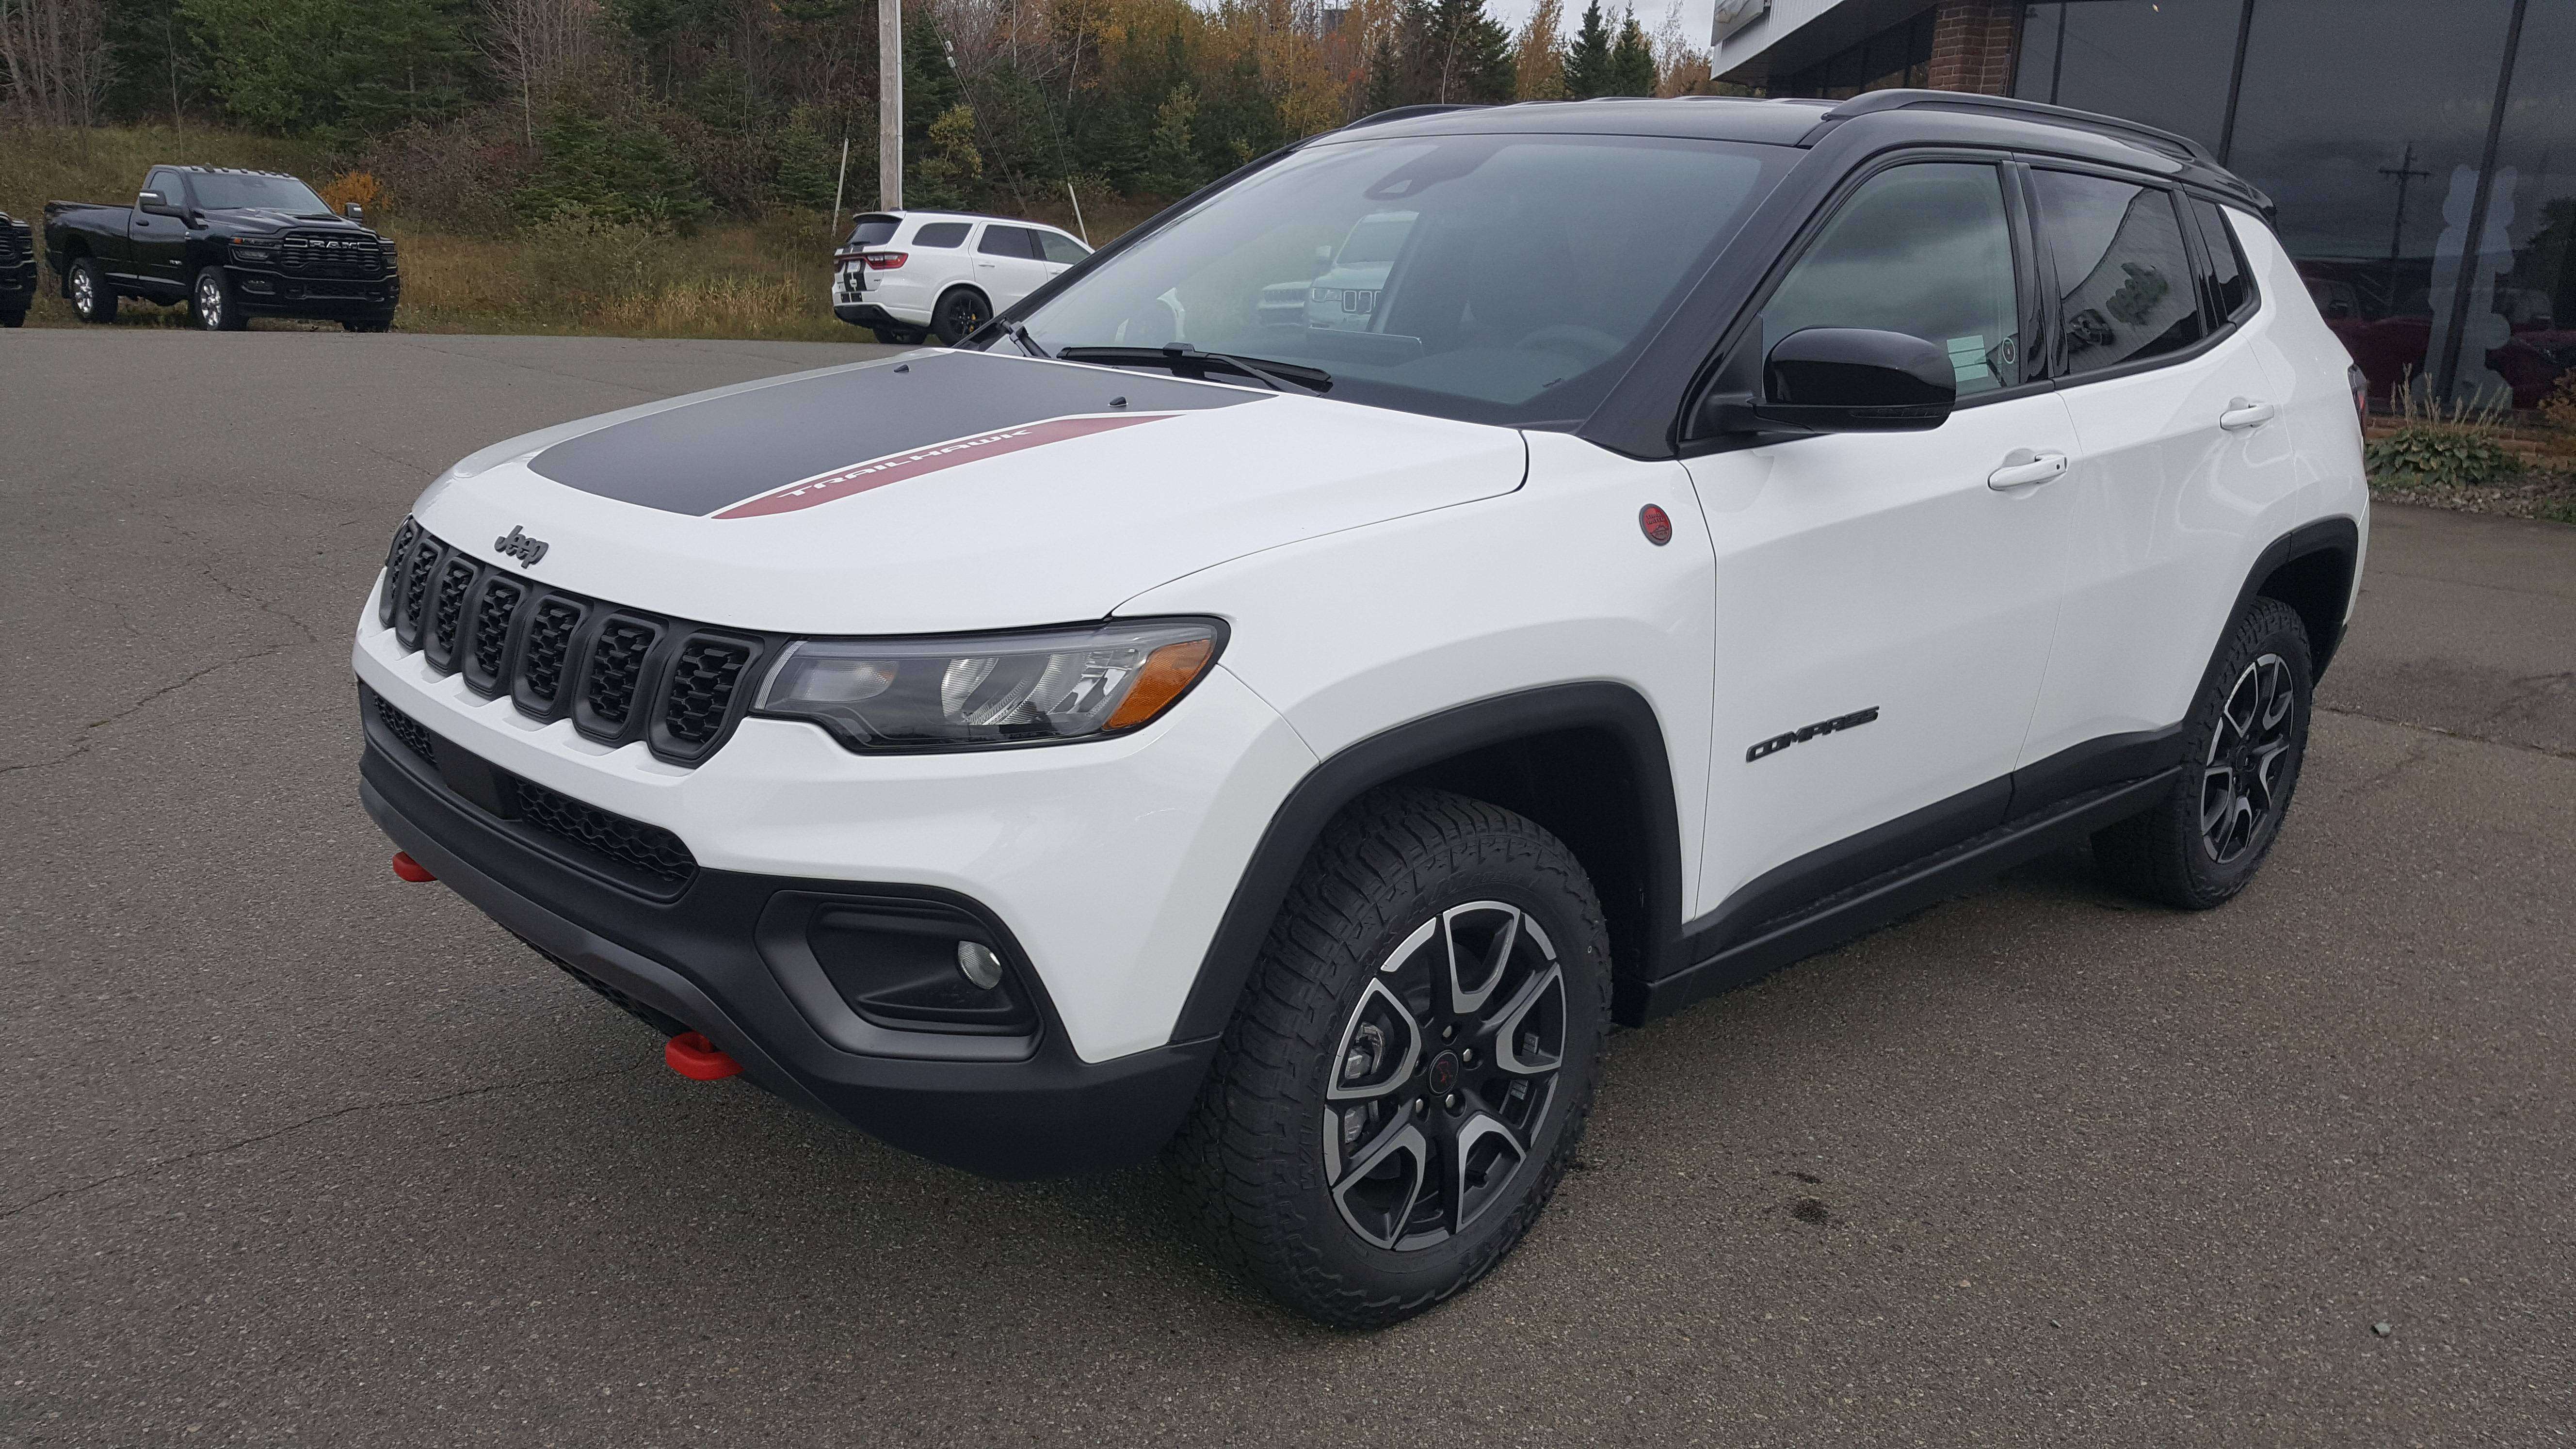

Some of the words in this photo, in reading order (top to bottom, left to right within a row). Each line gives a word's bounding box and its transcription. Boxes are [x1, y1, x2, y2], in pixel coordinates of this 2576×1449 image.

[309, 240, 357, 249] RAM
[777, 430, 1032, 498] TRAILHAWK
[494, 525, 549, 569] Jeep
[1745, 705, 1880, 763] COMPASS
